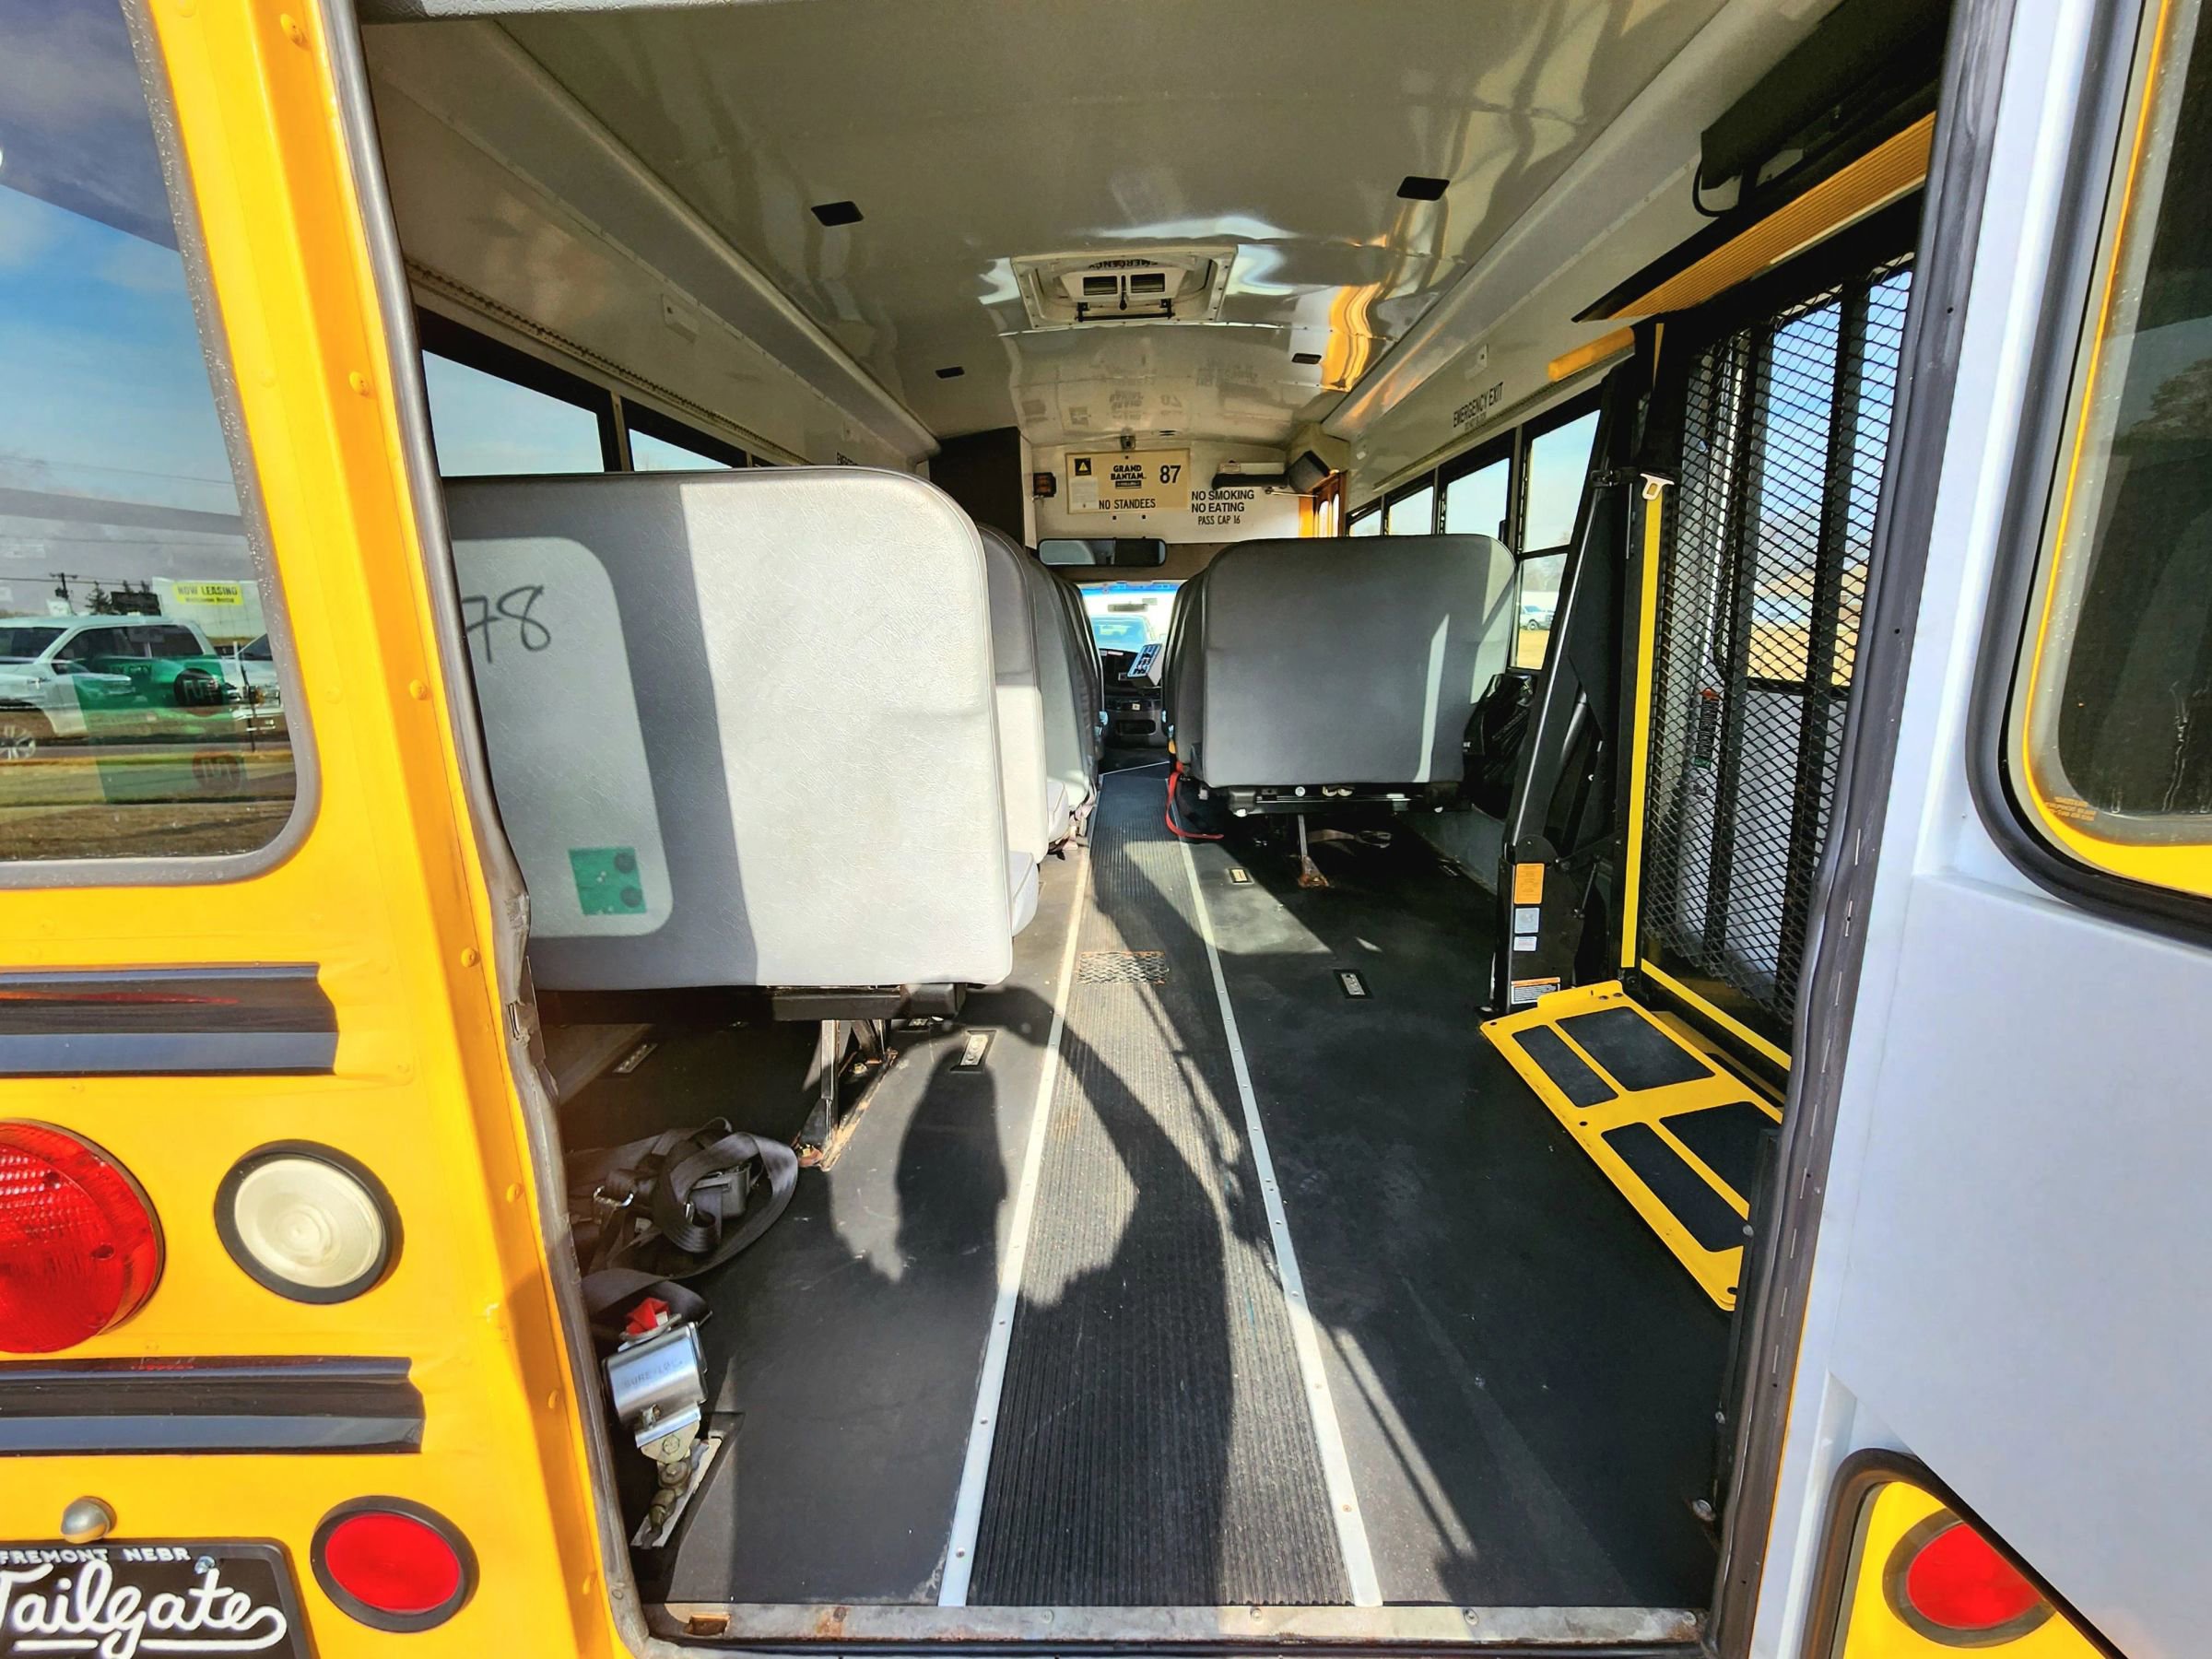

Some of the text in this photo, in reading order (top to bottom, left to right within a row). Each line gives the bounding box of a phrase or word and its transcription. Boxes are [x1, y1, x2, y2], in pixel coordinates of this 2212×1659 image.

[1453, 391, 1489, 428] EMERGENCY
[1488, 382, 1503, 406] EXIT
[1112, 465, 1142, 473] GRAND
[1159, 465, 1182, 484] 87
[1191, 489, 1254, 500] NO SMOKING
[1099, 499, 1156, 510] NO STANDEES
[1191, 502, 1245, 512] NO EATING
[1198, 515, 1241, 525] PASS CAP 16
[123, 1547, 191, 1562] NEBR
